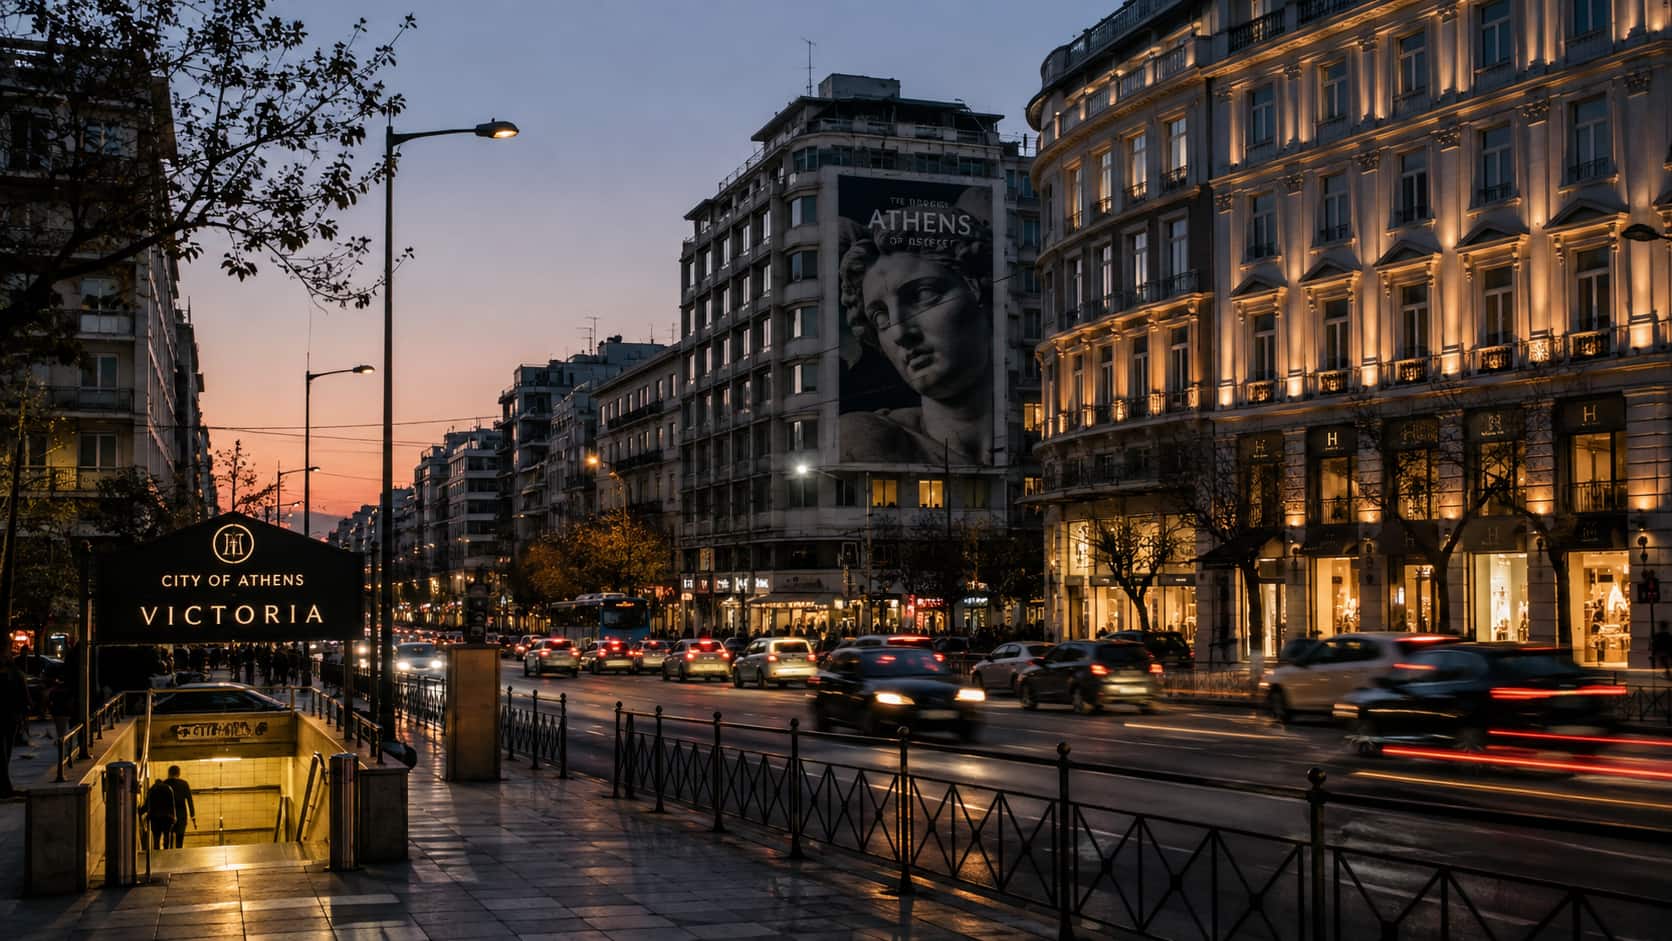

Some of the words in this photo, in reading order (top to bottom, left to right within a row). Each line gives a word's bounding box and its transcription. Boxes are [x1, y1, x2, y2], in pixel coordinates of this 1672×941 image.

[867, 208, 971, 236] ATHENS
[1583, 404, 1597, 423] H
[1327, 432, 1338, 446] H
[162, 575, 200, 587] CITY
[209, 575, 230, 586] OF
[238, 574, 303, 586] ATHENS
[140, 604, 323, 625] VICTORIA
